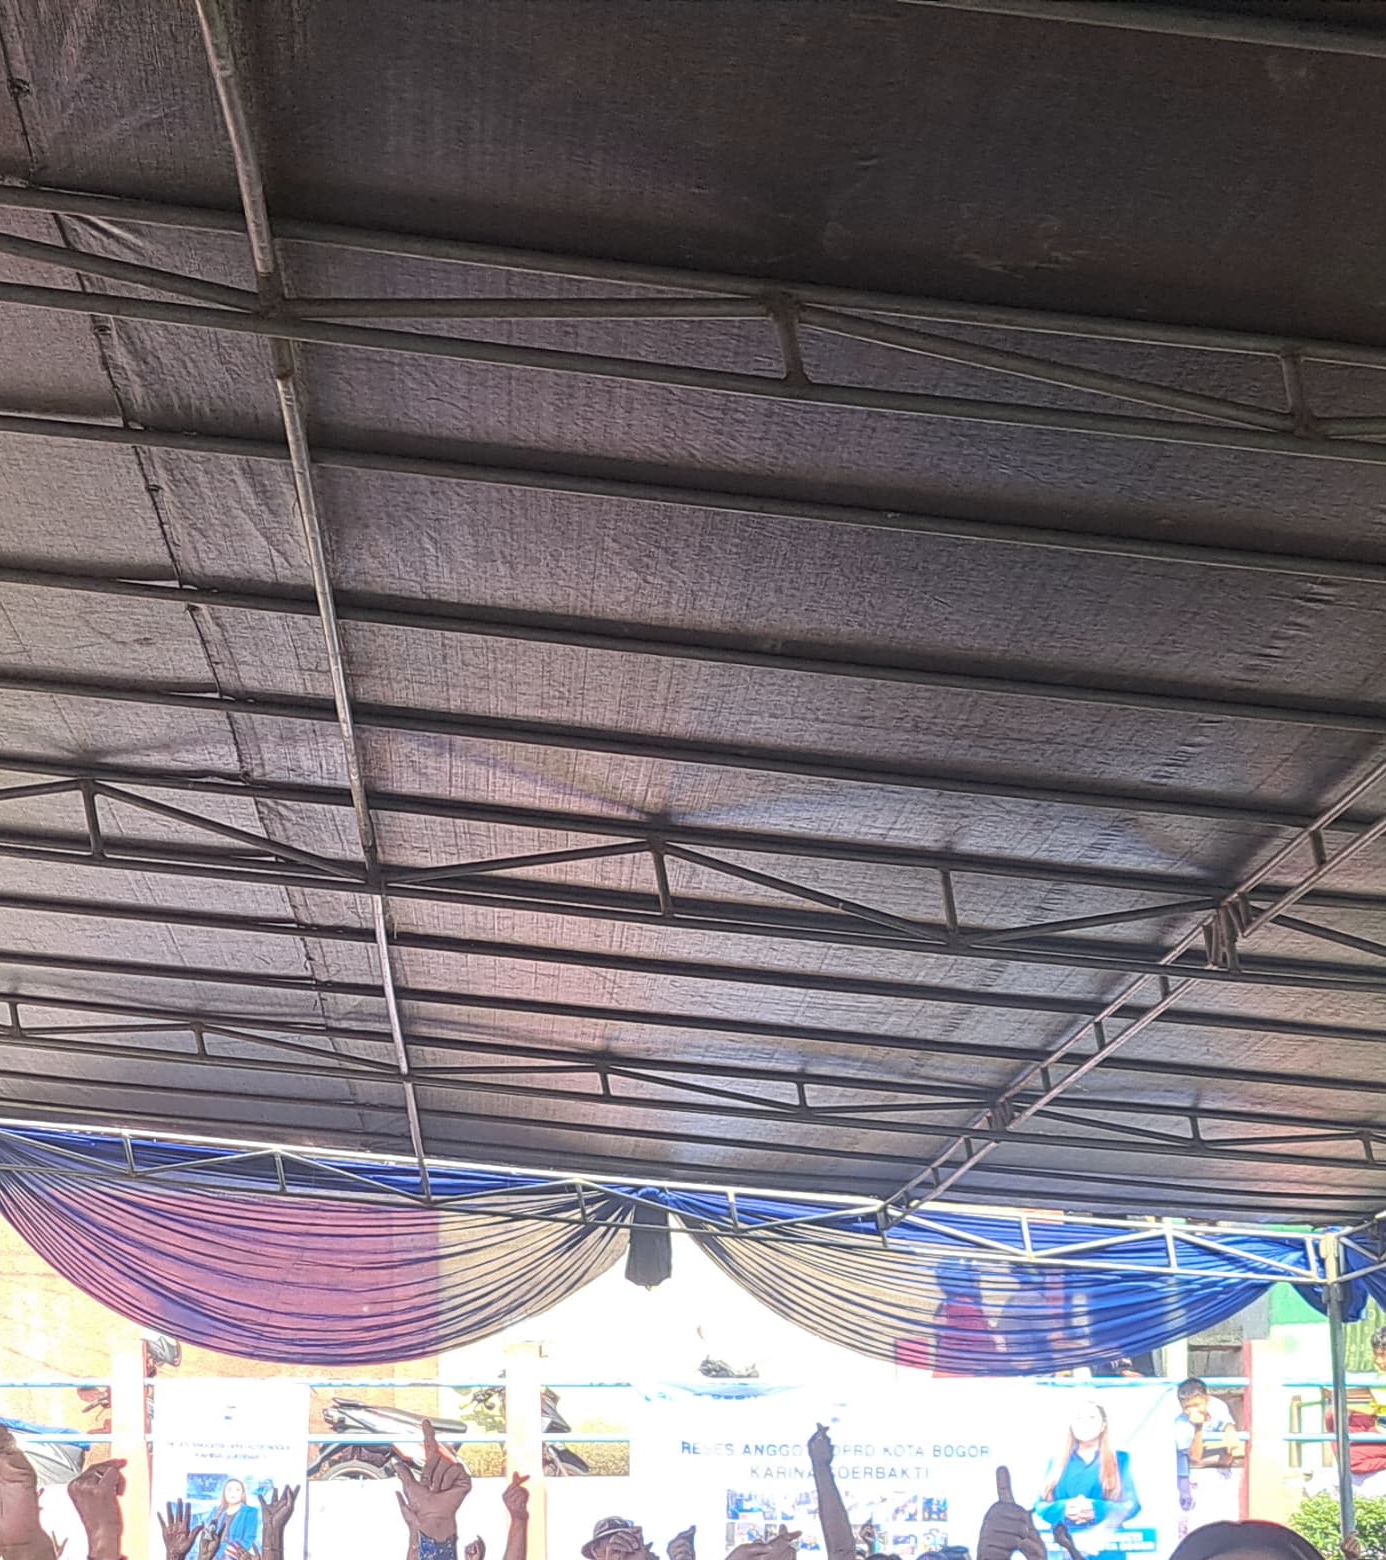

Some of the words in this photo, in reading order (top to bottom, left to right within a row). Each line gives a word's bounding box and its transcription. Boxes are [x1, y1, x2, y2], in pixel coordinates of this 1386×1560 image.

[681, 1440, 734, 1456] REES
[742, 1443, 810, 1457] ANGGO
[933, 1444, 990, 1458] BOGOR
[835, 1466, 929, 1480] OERBAKTI
